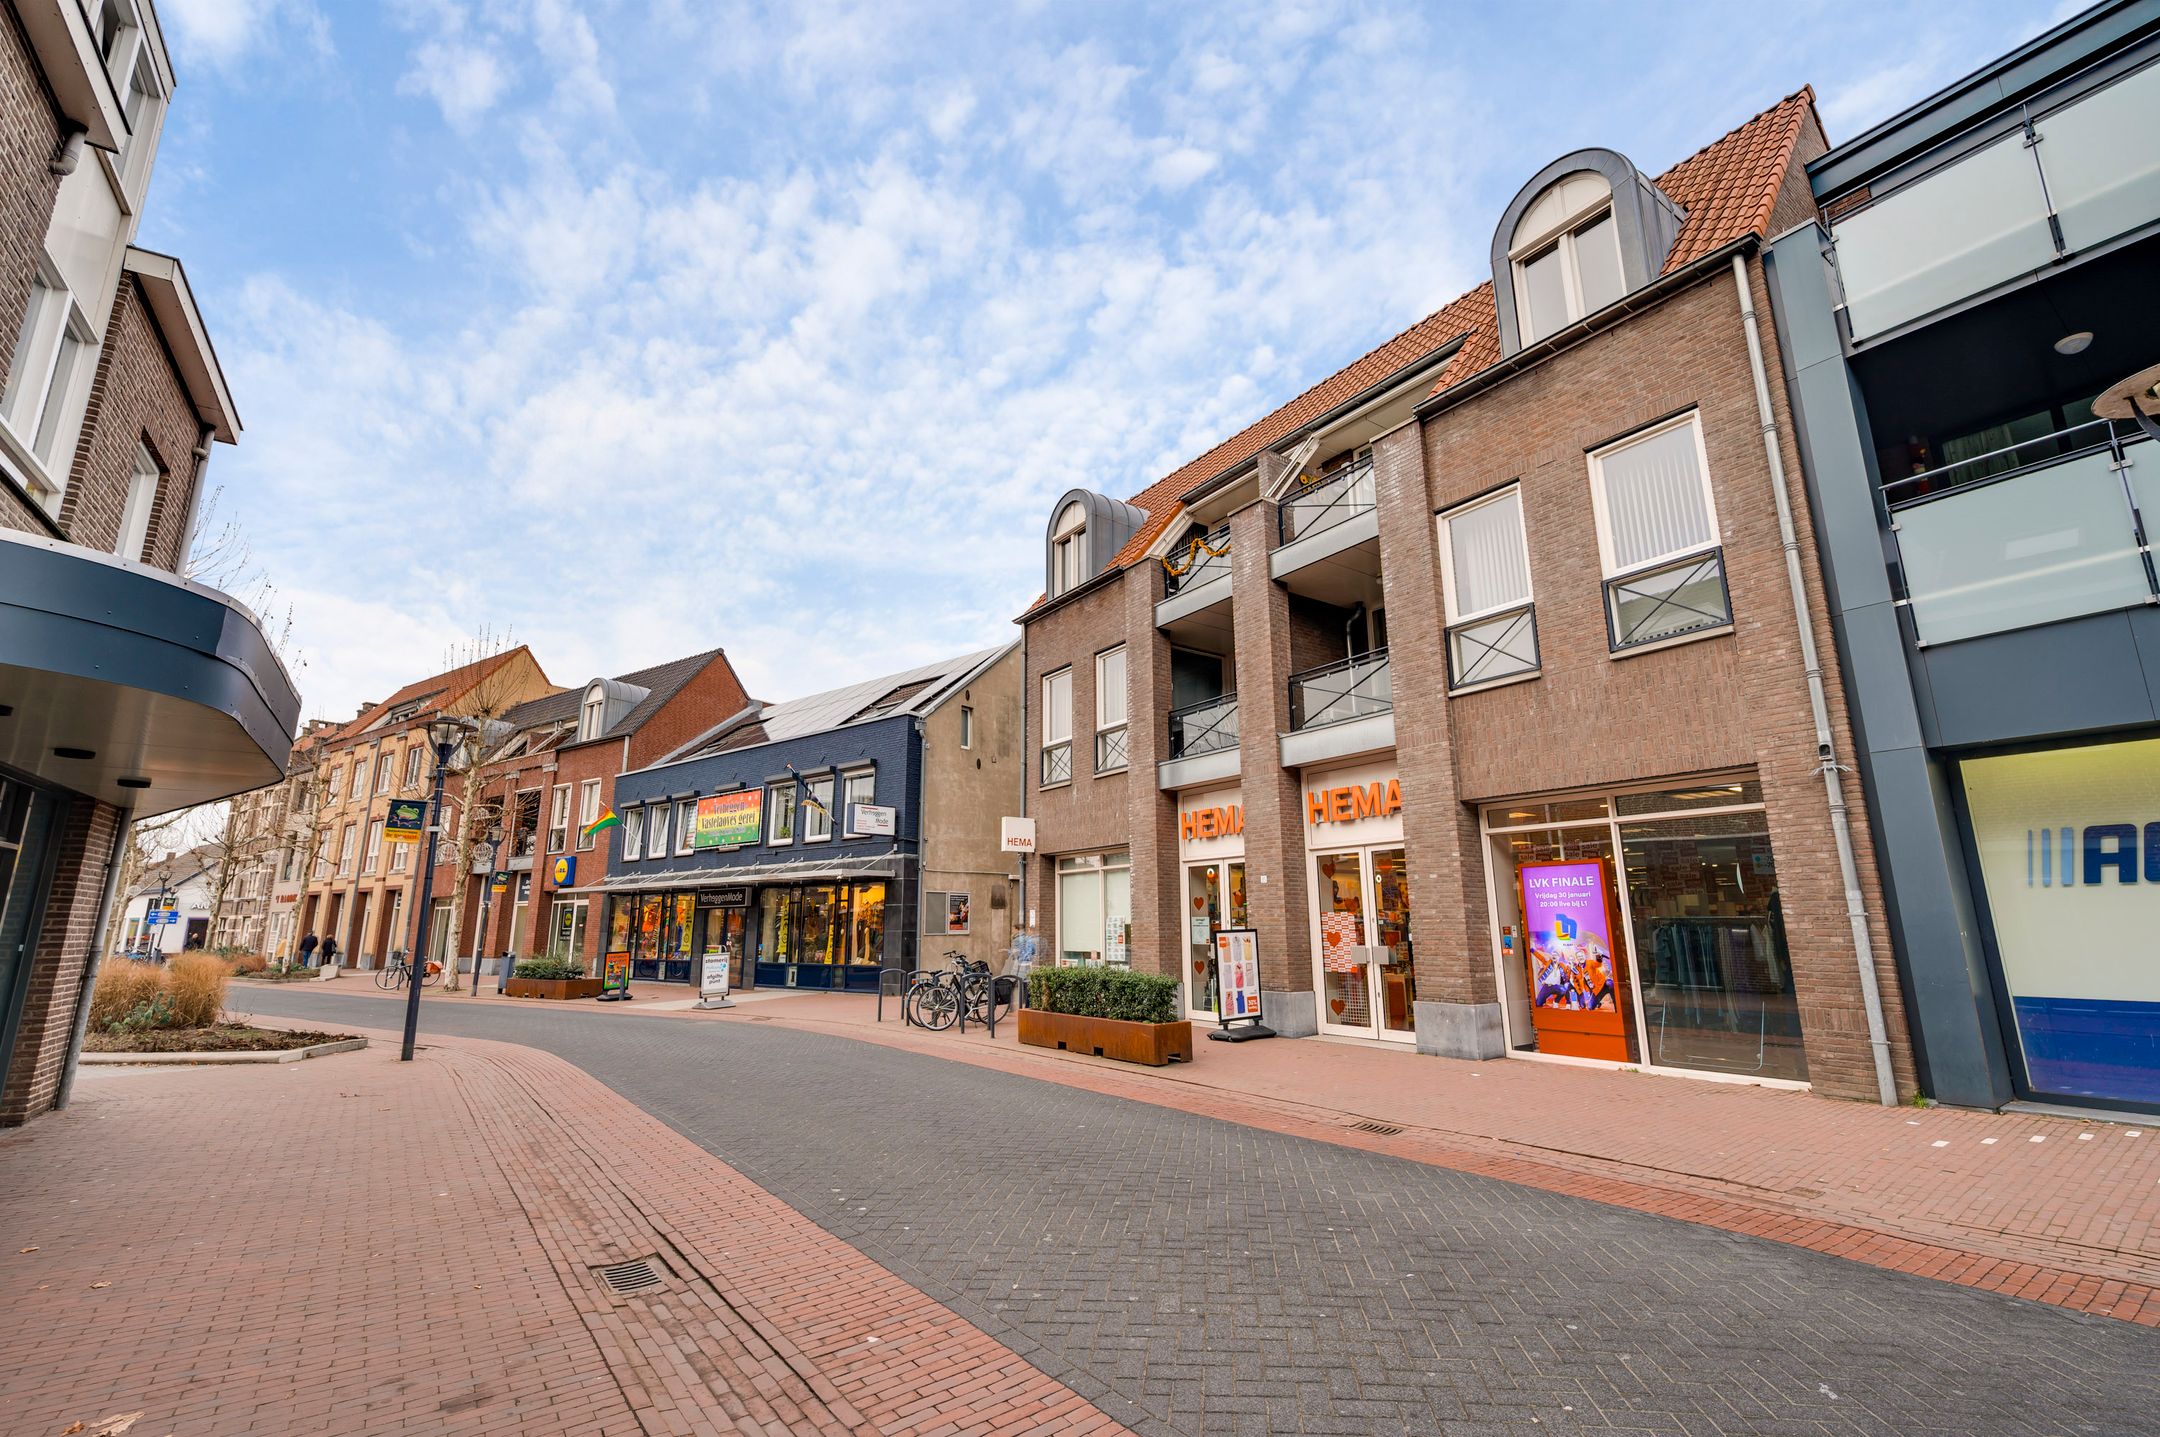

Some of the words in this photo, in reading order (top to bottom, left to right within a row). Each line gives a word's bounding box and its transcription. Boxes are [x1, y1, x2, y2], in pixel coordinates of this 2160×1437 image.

[1007, 837, 1033, 847] HEMA
[1529, 878, 1550, 888] LVK
[1552, 875, 1595, 887] FINALE
